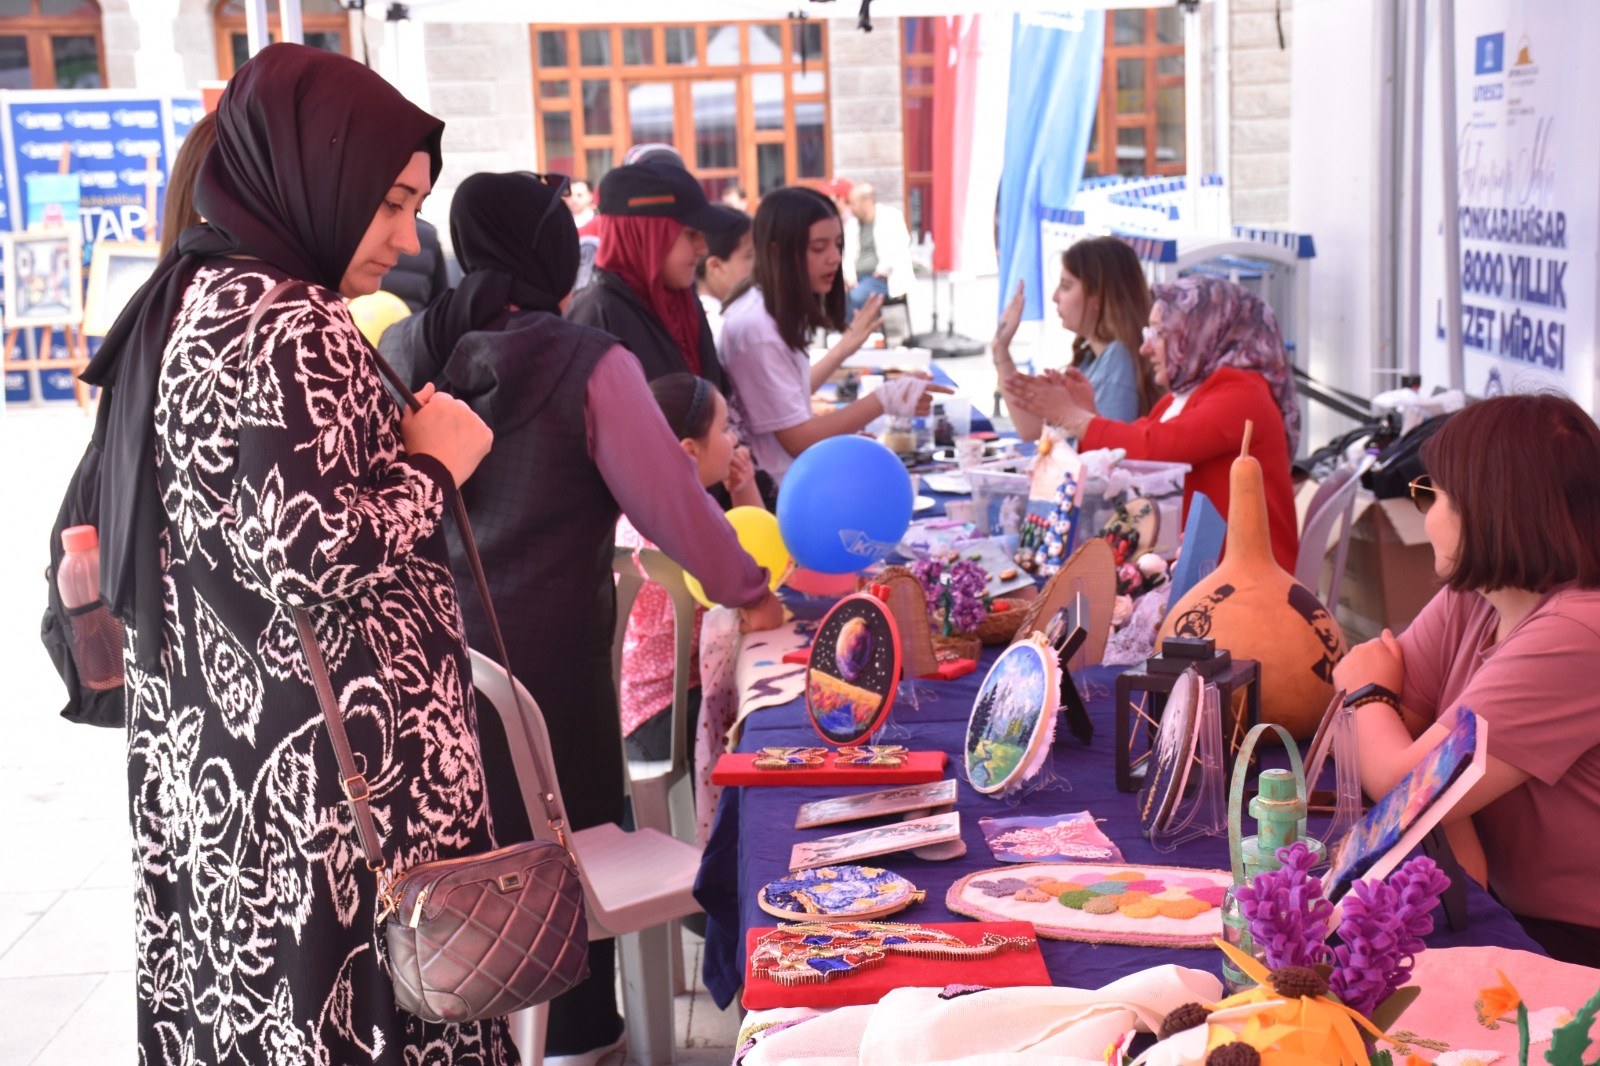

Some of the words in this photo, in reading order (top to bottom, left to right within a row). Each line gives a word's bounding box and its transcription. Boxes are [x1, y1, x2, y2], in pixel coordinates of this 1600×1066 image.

[1438, 204, 1567, 248] ONKARAHİSAR
[1463, 249, 1504, 297] 8000
[1509, 254, 1568, 309] YILLIK
[1437, 299, 1496, 352] LZET
[1500, 307, 1566, 371] MİRASI
